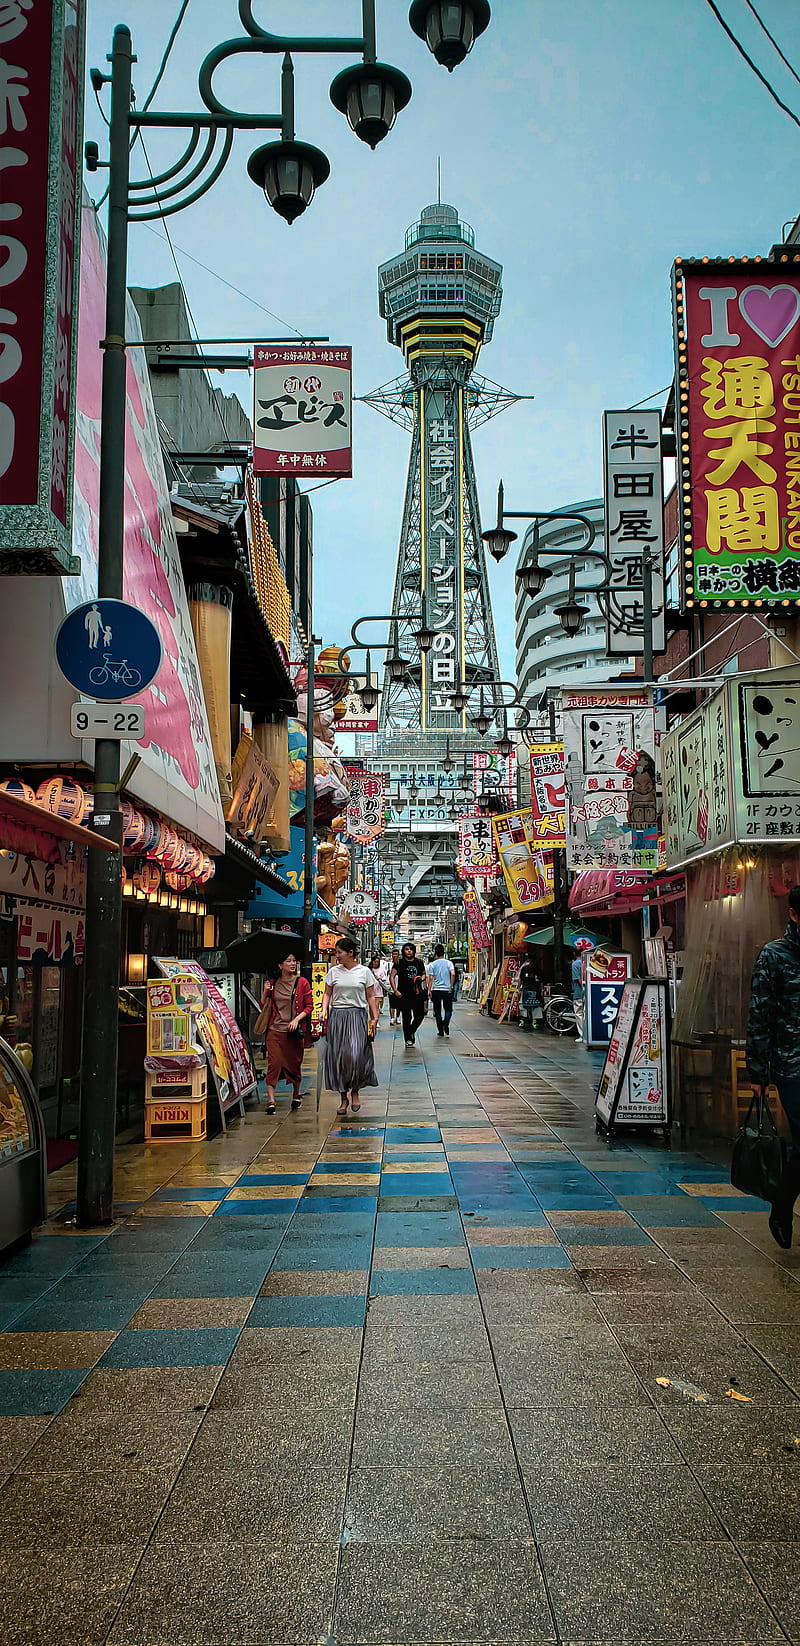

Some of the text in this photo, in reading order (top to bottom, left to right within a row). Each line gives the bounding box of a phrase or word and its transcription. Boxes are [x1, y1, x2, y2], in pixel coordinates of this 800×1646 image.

[699, 286, 740, 348] I
[277, 453, 328, 467] 年中無休
[700, 355, 782, 553] 通天閣
[428, 420, 455, 711] 社会イノベーションの日立
[698, 565, 741, 577] 日本一の
[698, 578, 741, 593] 串かつ
[567, 695, 649, 706] 元祖串カツ専門店
[532, 754, 559, 767] 新世界
[362, 778, 381, 826] 串かつ
[409, 809, 446, 819] EXPO
[746, 804, 761, 816] 1F
[746, 822, 761, 834] 2F
[471, 819, 492, 861] 串かつ
[571, 852, 656, 866] 宴会予約受付中
[593, 969, 625, 979] トラン
[154, 1110, 189, 1121] KIRIN
